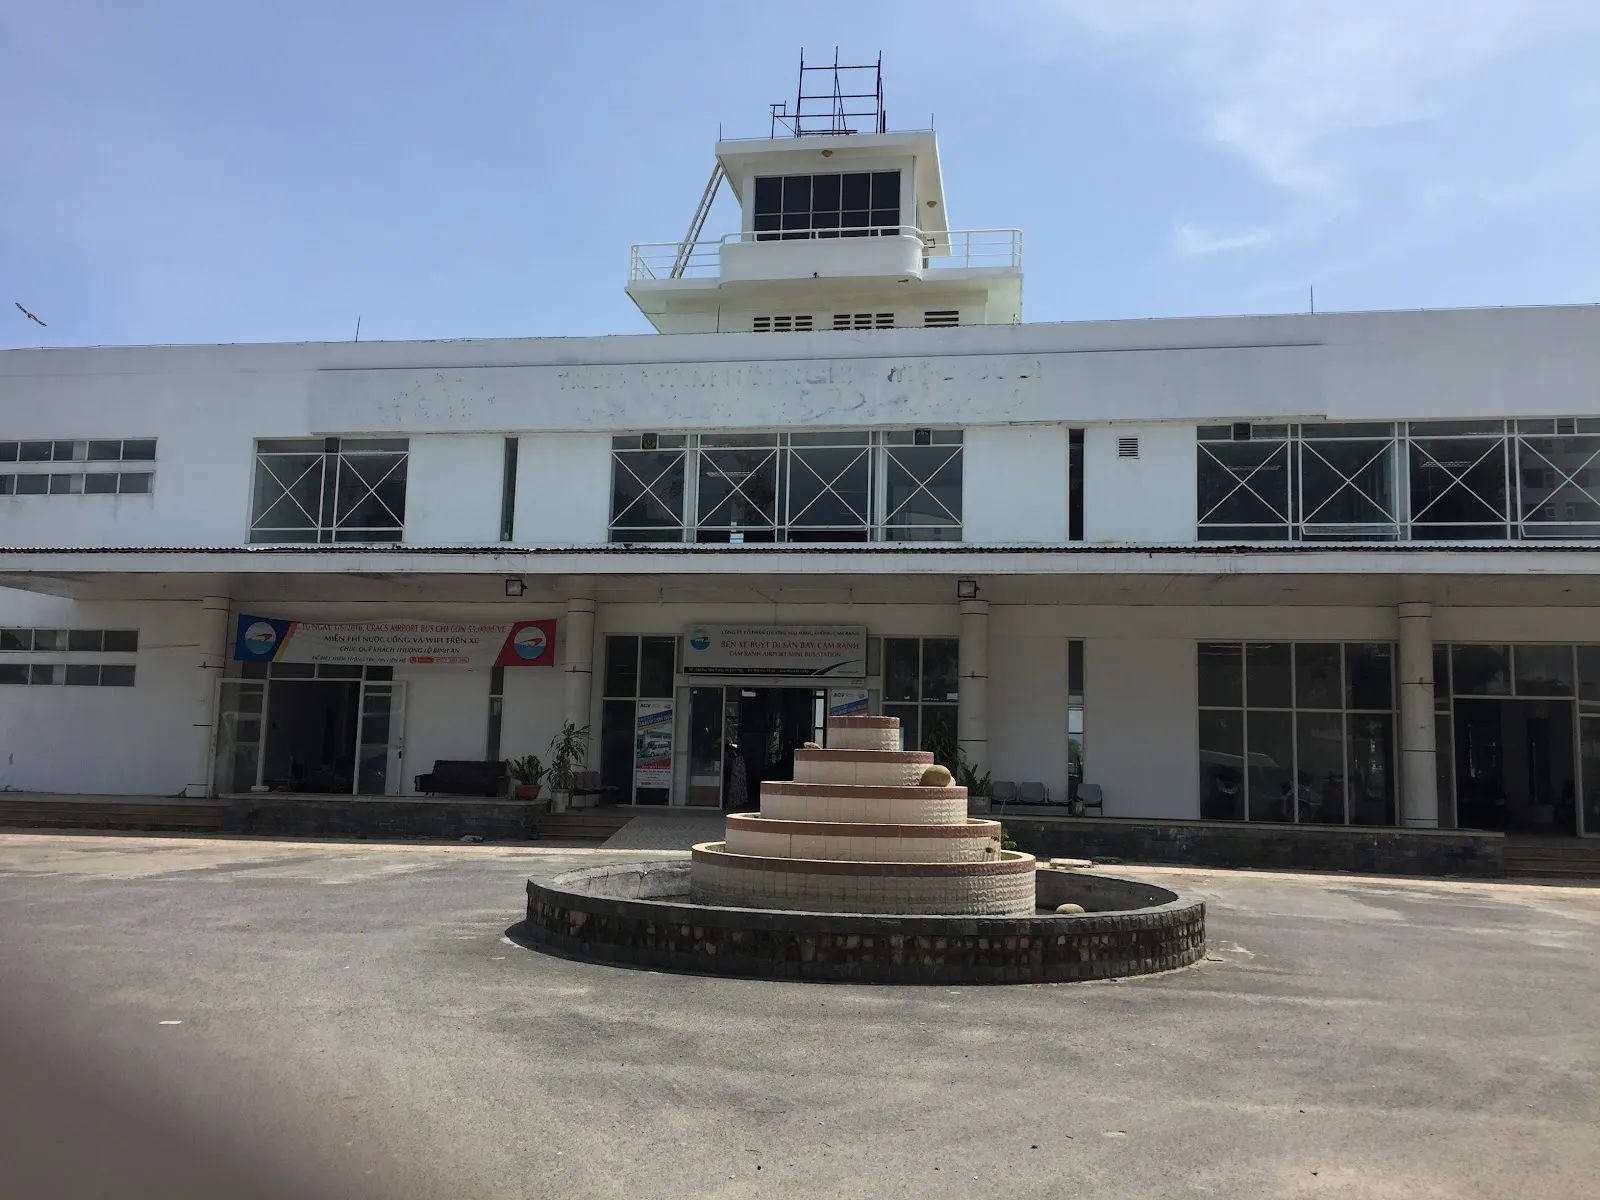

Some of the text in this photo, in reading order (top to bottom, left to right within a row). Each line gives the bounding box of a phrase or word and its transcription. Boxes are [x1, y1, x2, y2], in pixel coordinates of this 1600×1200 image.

[390, 624, 419, 633] AIRPORT
[420, 624, 435, 633] BUS
[446, 635, 467, 644] TRÊN
[800, 641, 815, 649] BAY
